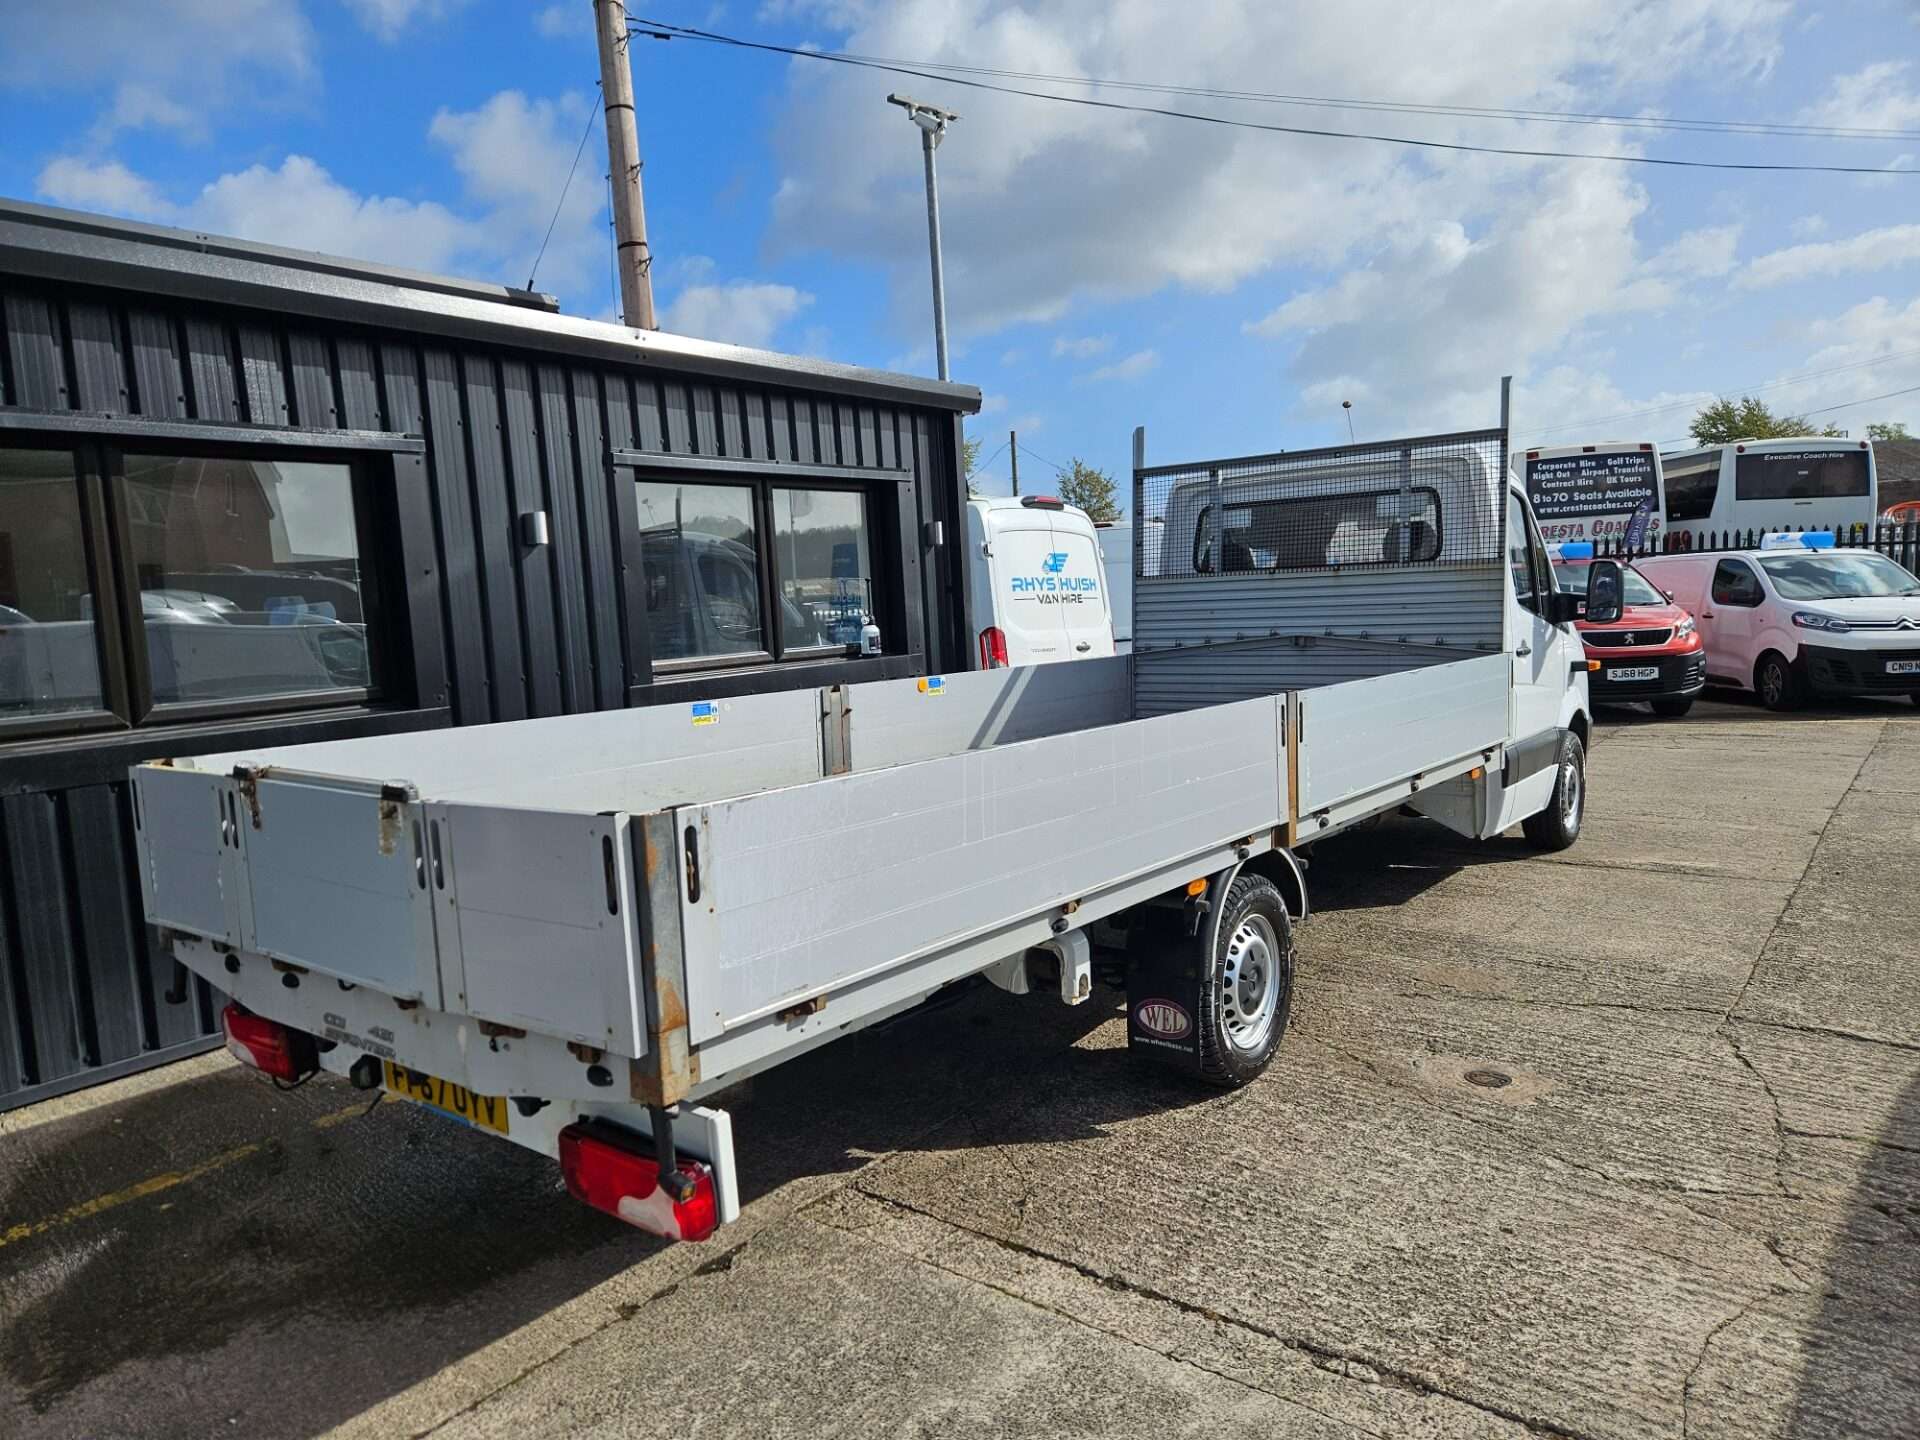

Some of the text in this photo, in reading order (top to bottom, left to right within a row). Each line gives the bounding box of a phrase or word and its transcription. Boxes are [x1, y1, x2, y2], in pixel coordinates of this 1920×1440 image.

[1537, 456, 1645, 471] Corporate Hire Golf Trips
[1764, 453, 1801, 461] Executive
[1803, 452, 1828, 460] Coach
[1532, 465, 1650, 480] Night Out Airport Transfers
[1541, 475, 1642, 488] Contract Hire UK Tours
[1533, 487, 1652, 504] 8 to 70 Seats Available
[1541, 523, 1585, 539] RESTA
[1011, 576, 1097, 592] RHYS HUISH
[1036, 593, 1084, 604] VAN HIRE
[1612, 668, 1655, 679] SJ68 HGP
[1891, 662, 1913, 672] CN19
[1144, 1007, 1183, 1032] WEL
